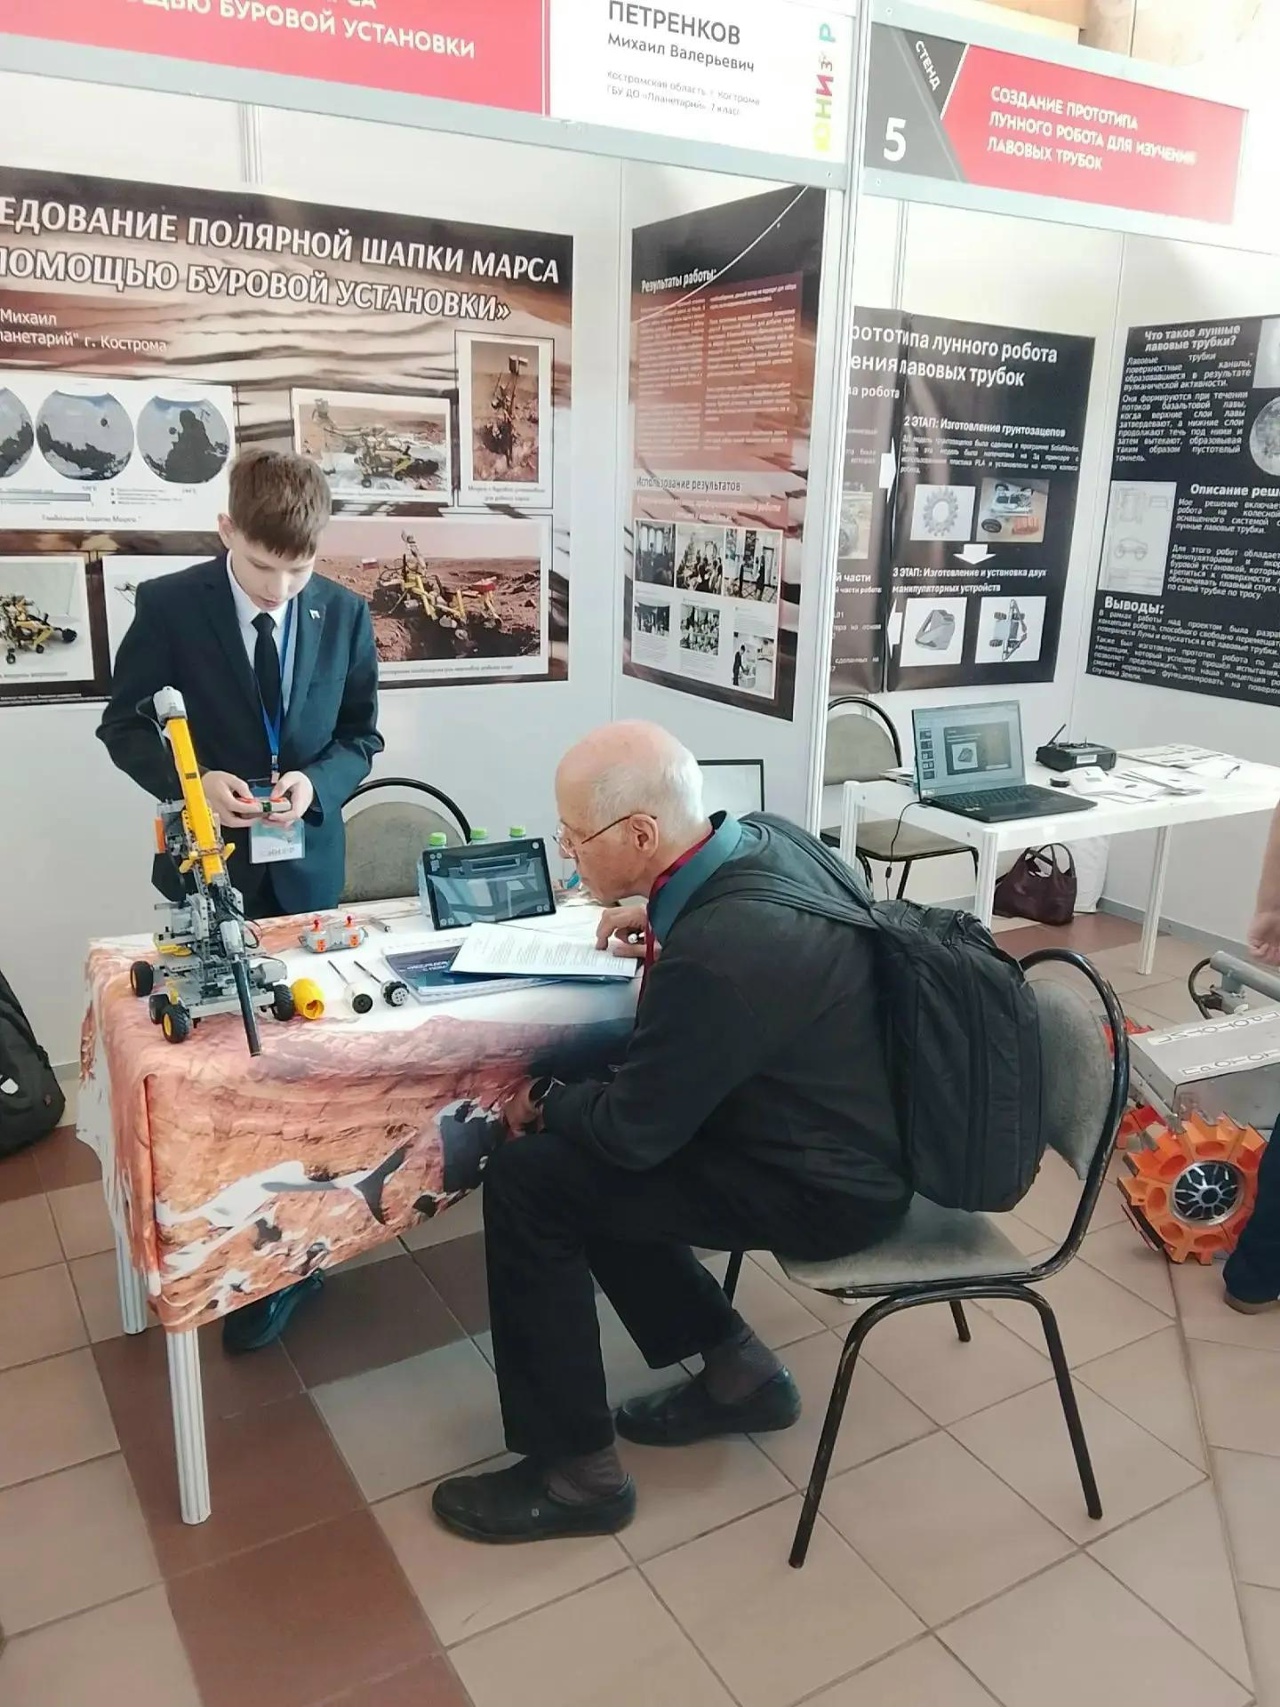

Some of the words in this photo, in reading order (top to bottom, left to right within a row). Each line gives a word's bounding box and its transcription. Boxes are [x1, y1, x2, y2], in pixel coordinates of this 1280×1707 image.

[220, 0, 335, 34] БУРОВОЙ
[343, 18, 475, 58] УСТАНОВКИ
[608, 0, 741, 45] ПЕТРЕНКОВ
[608, 33, 665, 54] Михаил
[670, 44, 754, 72] Валерьевич
[915, 40, 941, 90] СТЕНД
[991, 87, 1063, 114] СОЗДАНИЕ
[1067, 102, 1139, 130] ПРОТОТИПА
[883, 117, 907, 161] 5
[989, 112, 1053, 136] ЛУННОГО
[1056, 124, 1104, 146] РОБОТА
[1107, 136, 1133, 154] ДЛЯ
[987, 138, 1053, 161] ЛАВОВЫХ
[1056, 148, 1103, 171] ТРУБОК
[186, 216, 352, 262] ПОЛЯРНОЙ
[360, 237, 464, 273] ШАПКИ
[470, 249, 560, 284] МАРСА
[186, 264, 329, 304] БУРОВОЙ
[335, 279, 512, 321] УСТАНОВКИ»
[641, 276, 682, 294] Результаты
[0, 308, 57, 326] Михаил
[84, 336, 96, 347] г.
[101, 337, 167, 353] Кострома
[932, 333, 998, 356] лунного
[1002, 342, 1057, 363] робота
[1145, 331, 1163, 340] Что
[1166, 329, 1195, 339] такое
[1145, 341, 1189, 352] лавовые
[1192, 335, 1236, 350] трубки?
[899, 359, 966, 381] лавовых
[969, 366, 1025, 388] трубок
[862, 386, 900, 399] робота
[904, 416, 910, 426] 2
[912, 416, 939, 428] ЭТАП:
[941, 418, 1000, 433] Изготовление
[691, 480, 741, 492] результатов
[1190, 484, 1248, 496] Описание
[844, 574, 871, 582] части
[1105, 596, 1165, 614] Выводы:
